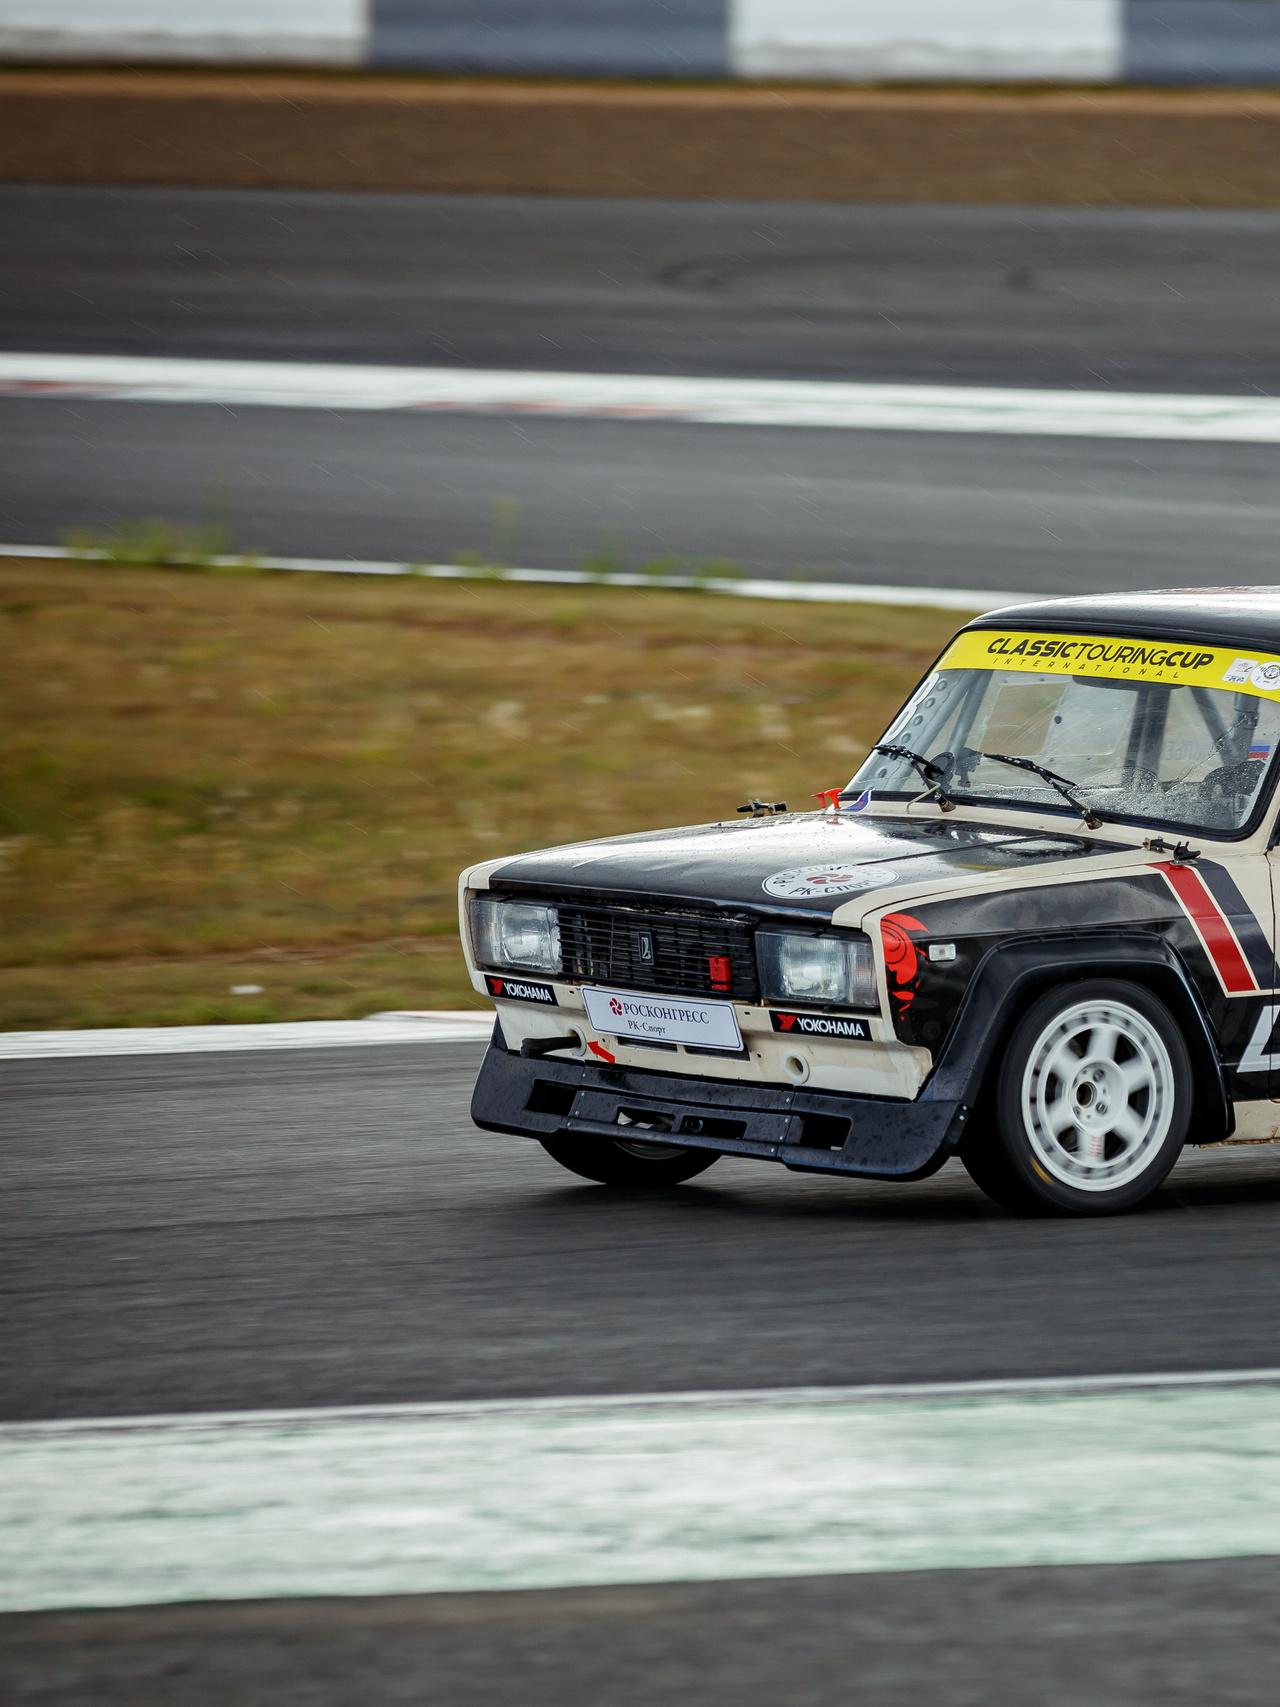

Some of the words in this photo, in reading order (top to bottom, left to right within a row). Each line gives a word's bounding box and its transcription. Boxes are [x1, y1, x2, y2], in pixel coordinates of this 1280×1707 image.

[987, 638, 1215, 670] CLASSICTOURINGCUP
[992, 657, 1179, 679] INTERNATIONAL
[503, 982, 553, 1002] YOKOHAMA
[622, 1002, 710, 1024] РОСКОНГРЕСС
[627, 1019, 666, 1037] РК-Спорт
[796, 1017, 865, 1037] YOKOHAMA
